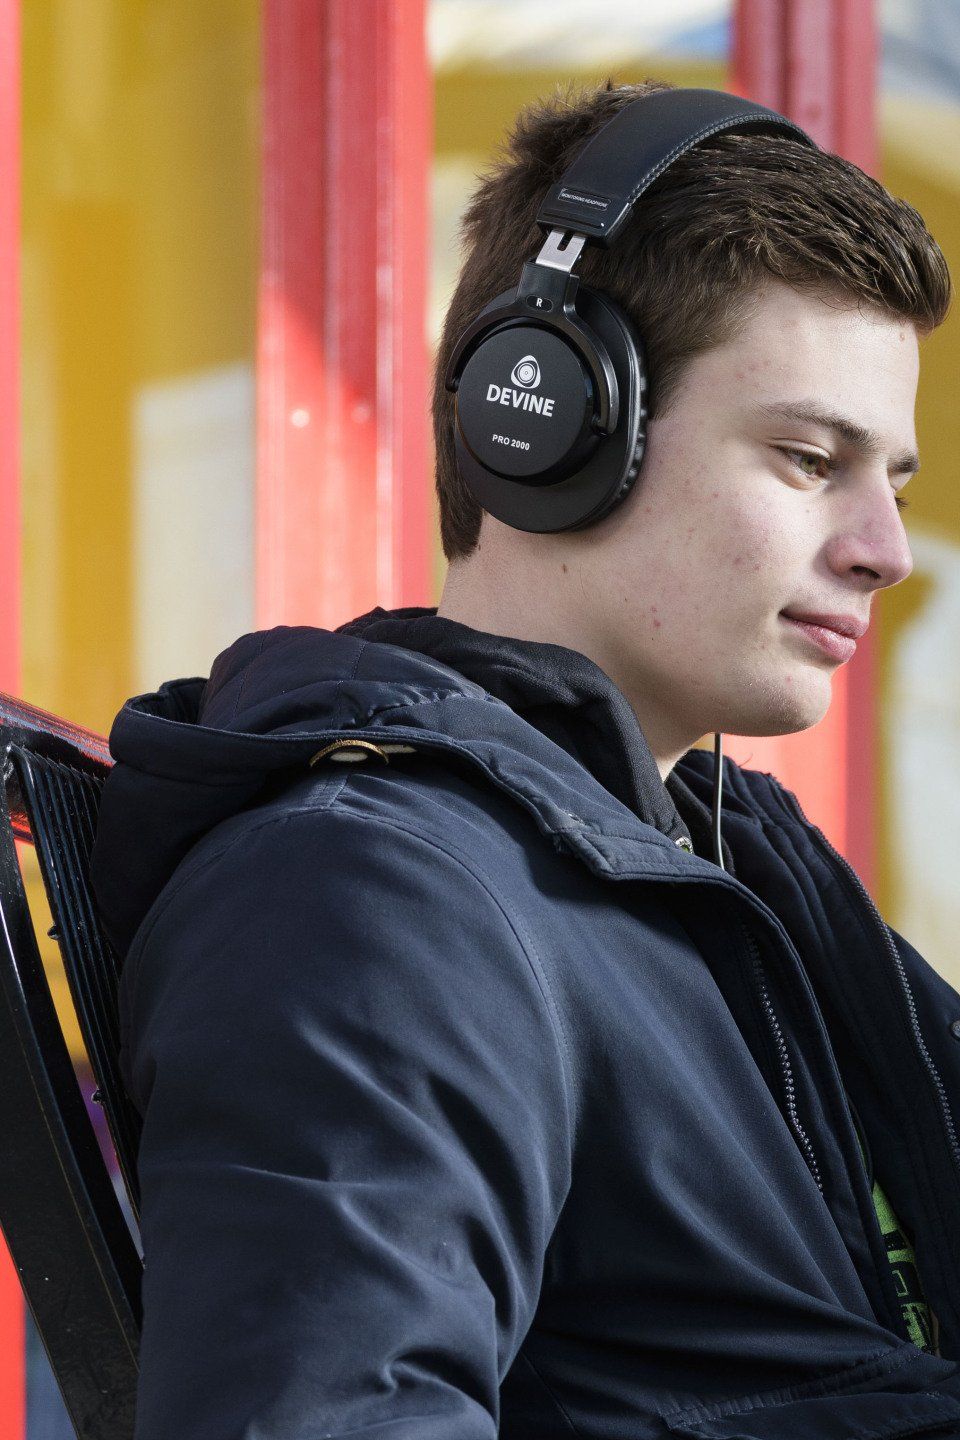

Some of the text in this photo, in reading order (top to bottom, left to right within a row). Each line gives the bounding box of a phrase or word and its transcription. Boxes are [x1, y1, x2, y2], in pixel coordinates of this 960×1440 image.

[536, 297, 543, 308] R
[486, 383, 555, 418] DEVINE
[492, 434, 530, 451] PRO 2000
